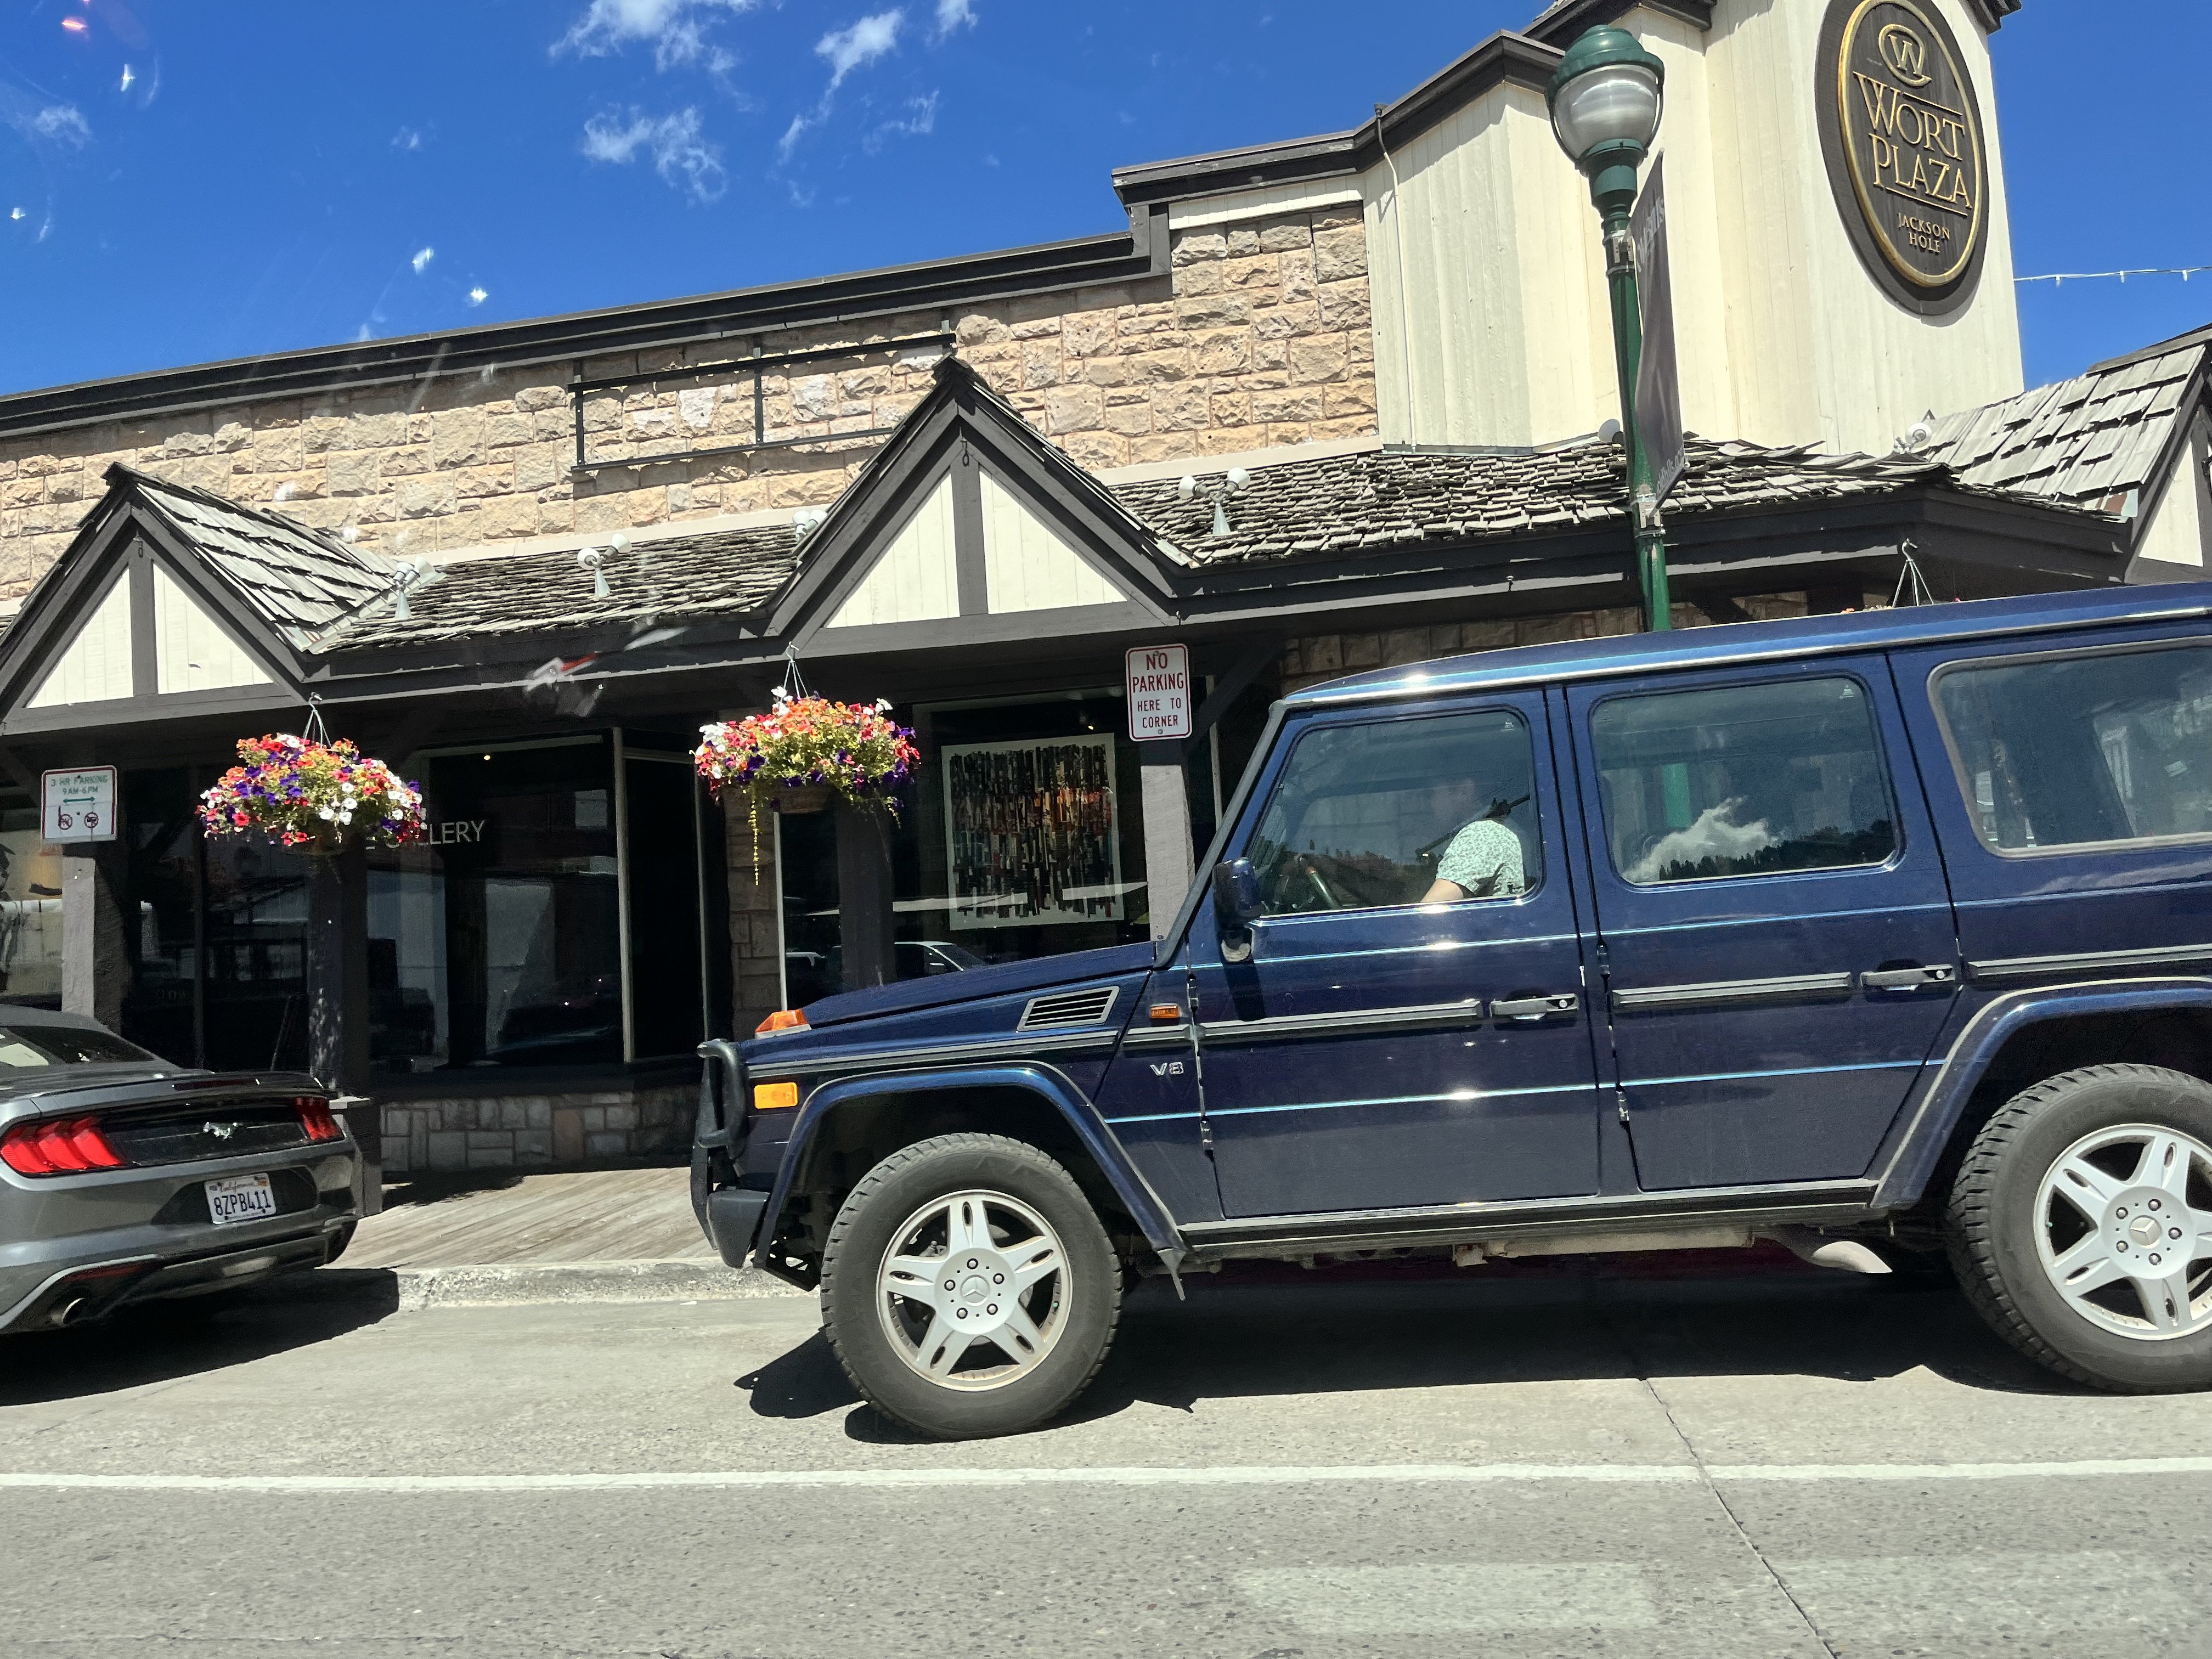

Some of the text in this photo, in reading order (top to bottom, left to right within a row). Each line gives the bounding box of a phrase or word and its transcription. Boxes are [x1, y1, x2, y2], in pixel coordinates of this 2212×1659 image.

[1853, 71, 1965, 161] WORT
[1869, 132, 1973, 209] PLAZA
[1897, 212, 1951, 241] JACKSON
[1909, 231, 1941, 253] HOLE
[1146, 652, 1168, 670] NO
[1132, 672, 1184, 693] PARKING
[1137, 697, 1182, 712] HERE TO
[1142, 714, 1179, 729] CORNER
[50, 775, 109, 787] 3 HR PARKING
[1149, 1062, 1184, 1076] V8
[213, 1189, 272, 1216] 8ZPB411
